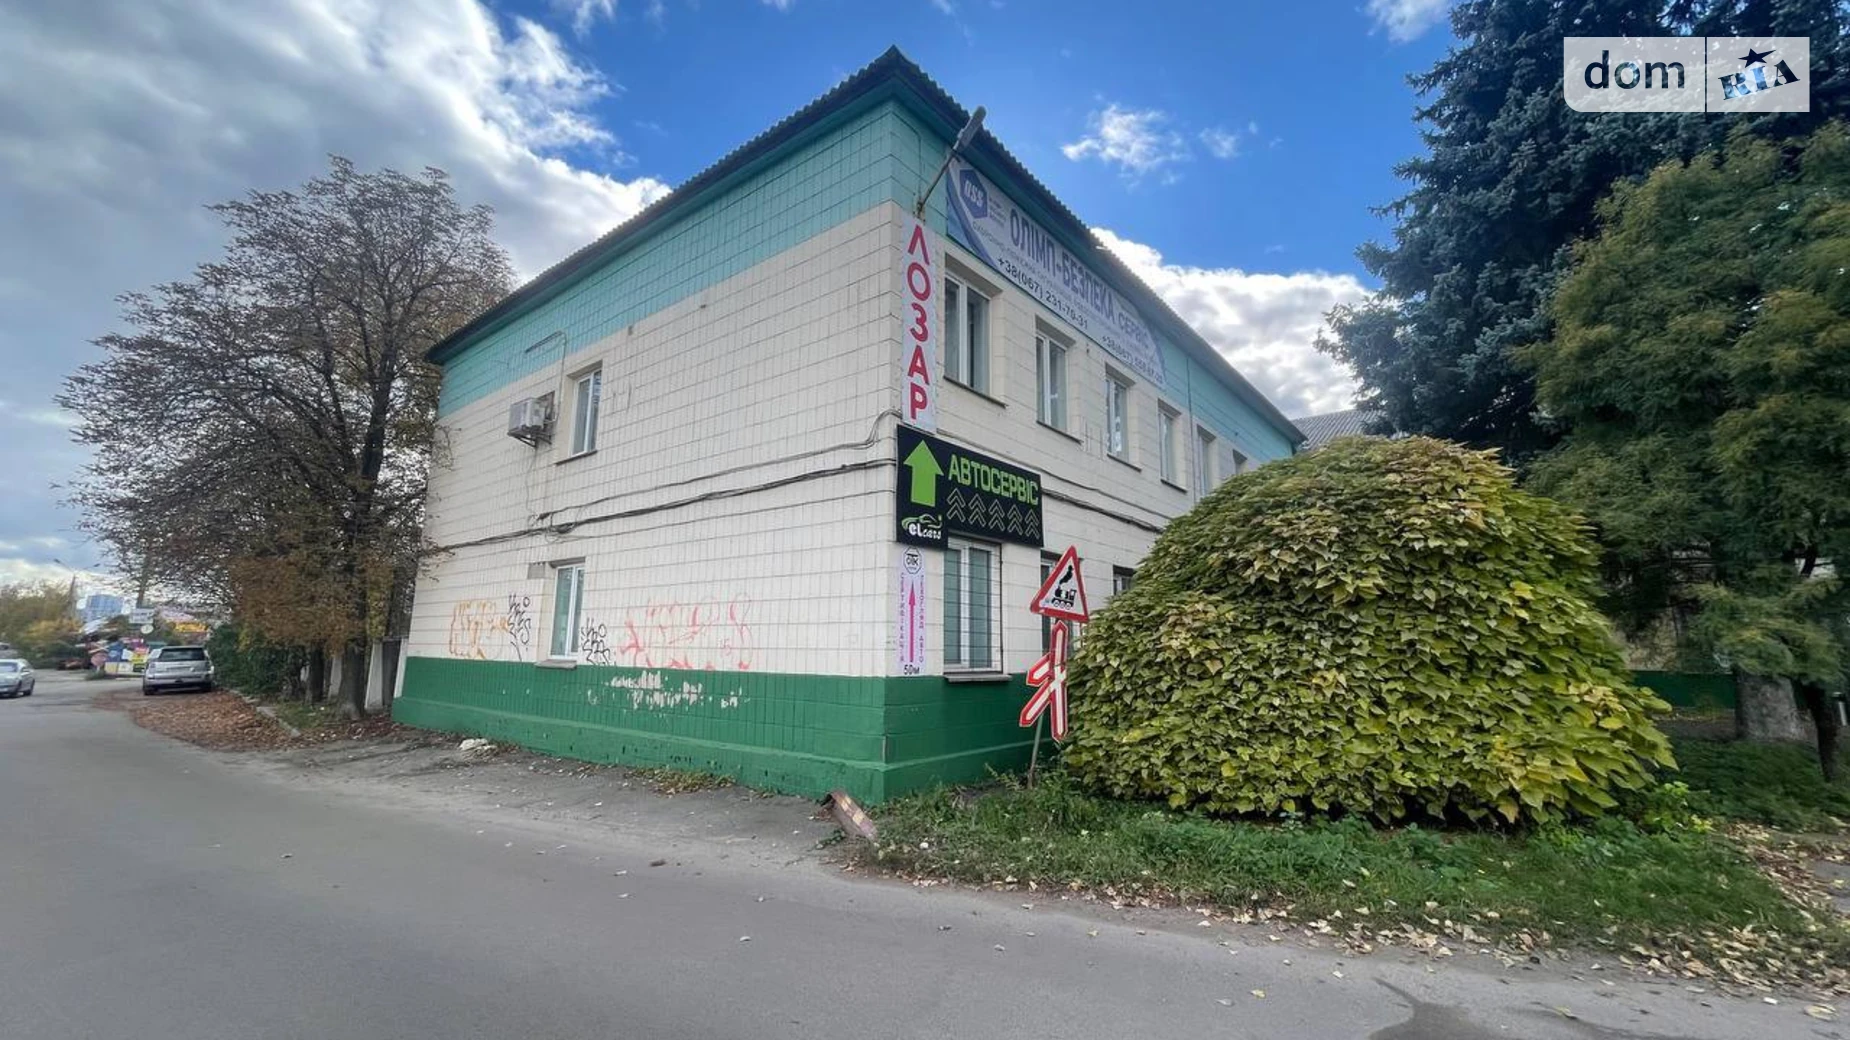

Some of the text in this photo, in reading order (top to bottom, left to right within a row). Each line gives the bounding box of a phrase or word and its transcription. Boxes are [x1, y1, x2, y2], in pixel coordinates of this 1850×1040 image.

[906, 225, 931, 419] ЛОЗАР
[1010, 208, 1115, 324] ОЛІМП-БЕЗПЕКА
[949, 454, 1039, 505] АВТОСЕРВІС
